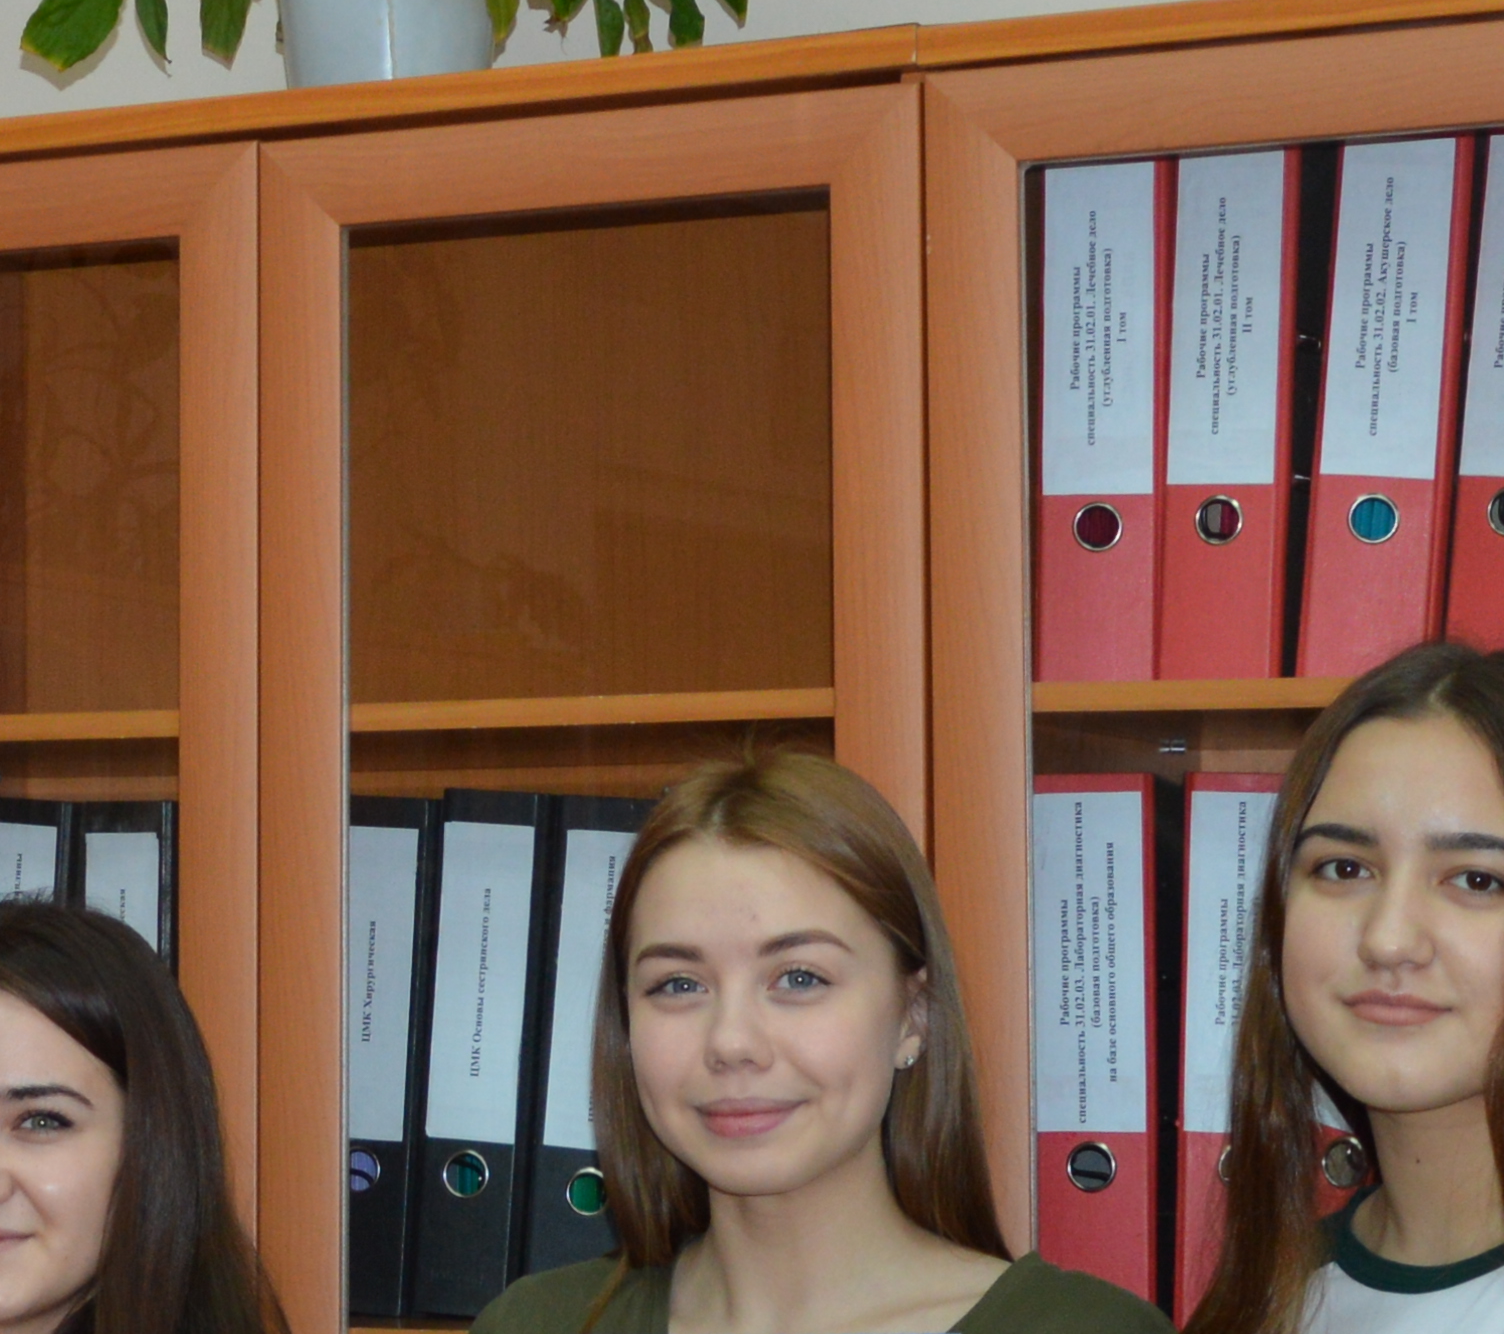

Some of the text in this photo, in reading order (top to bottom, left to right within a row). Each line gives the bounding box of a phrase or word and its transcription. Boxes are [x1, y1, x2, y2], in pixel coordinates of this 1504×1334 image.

[1069, 266, 1083, 390] Рабочие программы
[1084, 210, 1097, 446] специальность 31.02.01. Лечебное дело
[1101, 247, 1113, 407] (углубленная подготовка)
[1118, 311, 1127, 334] том
[1354, 242, 1375, 369] Рабочие программы
[1368, 176, 1395, 436] специальность 31.02.02. Акушерское дело
[1386, 240, 1406, 373] (базовая подготовка)
[1408, 291, 1419, 314] том
[1104, 841, 1115, 920] образования
[360, 919, 378, 1043] ЦМК Хирургическая
[468, 887, 492, 1077] ЦМК Основы сестринского дела
[1059, 899, 1071, 1026] Рабочие программы
[1073, 801, 1087, 1124] специальность 31.02.03. Лабораторная диагностика
[1090, 895, 1101, 1028] (базовая подготовка)
[1104, 922, 1116, 968] общего
[1107, 971, 1117, 1035] основного
[1106, 1038, 1117, 1064] базе
